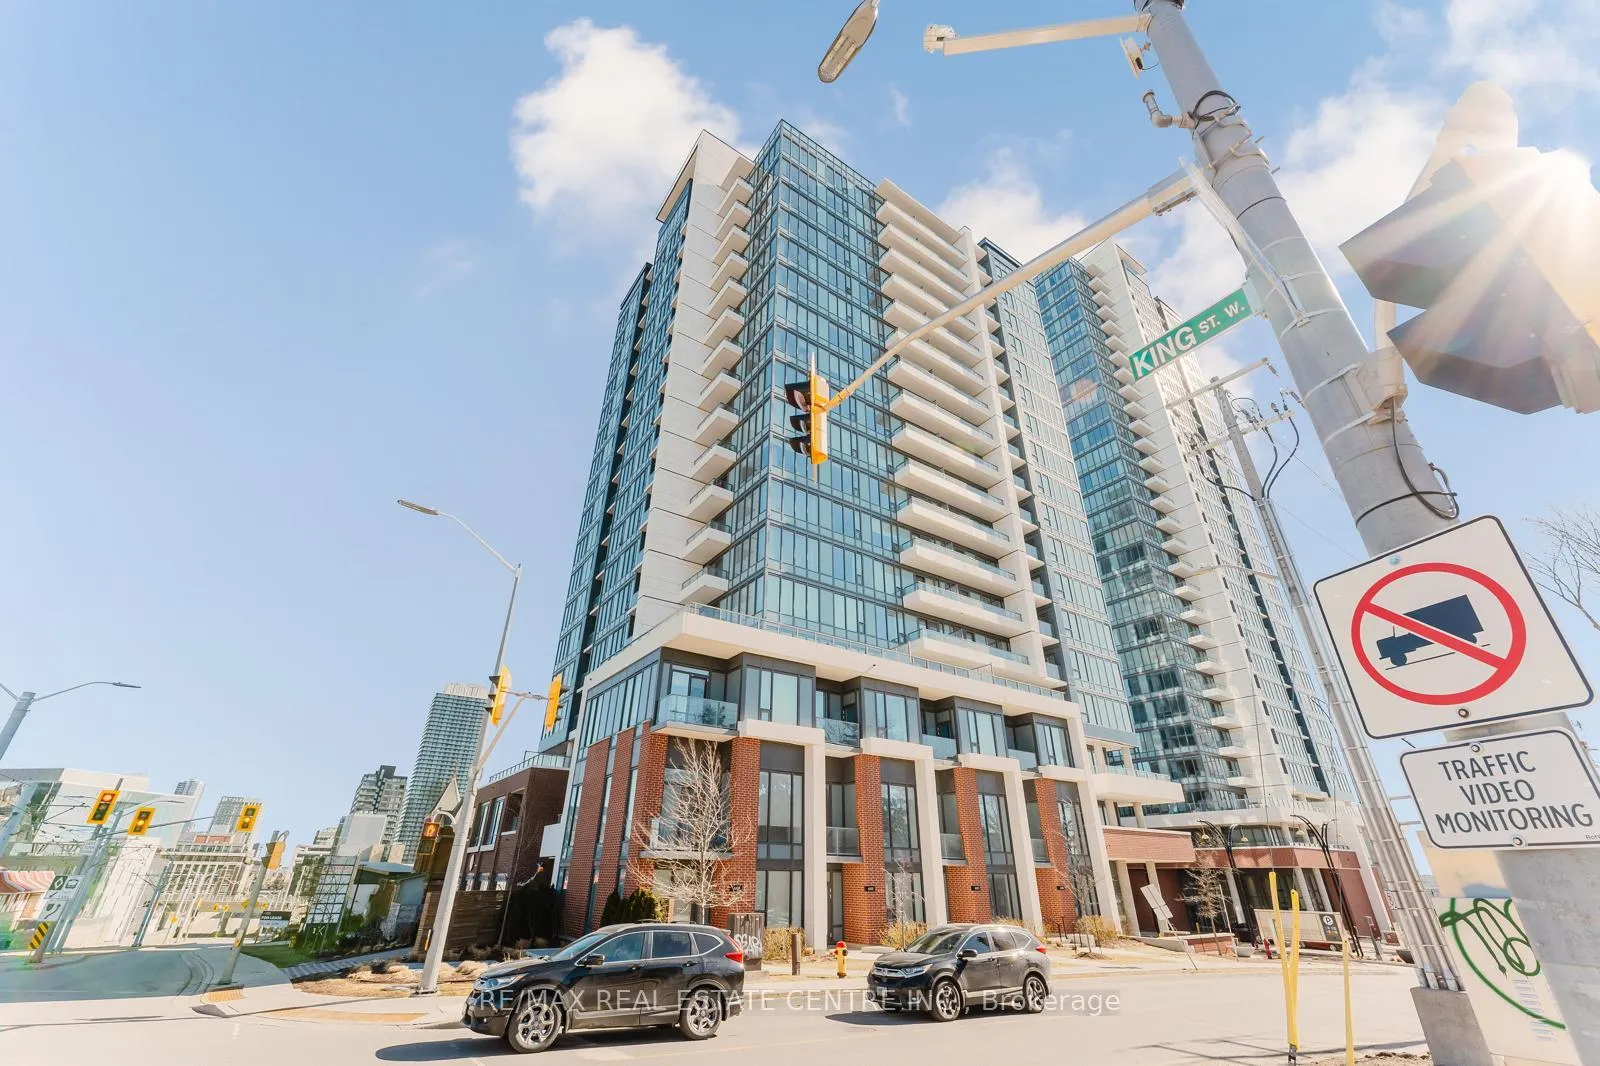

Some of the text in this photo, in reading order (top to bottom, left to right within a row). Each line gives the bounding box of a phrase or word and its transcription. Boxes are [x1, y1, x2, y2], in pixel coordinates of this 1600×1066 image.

[1133, 301, 1245, 379] KING ST. W.
[1438, 750, 1536, 781] TRAFFIC
[1459, 779, 1535, 806] VIDEO
[1435, 803, 1593, 834] MONITORING
